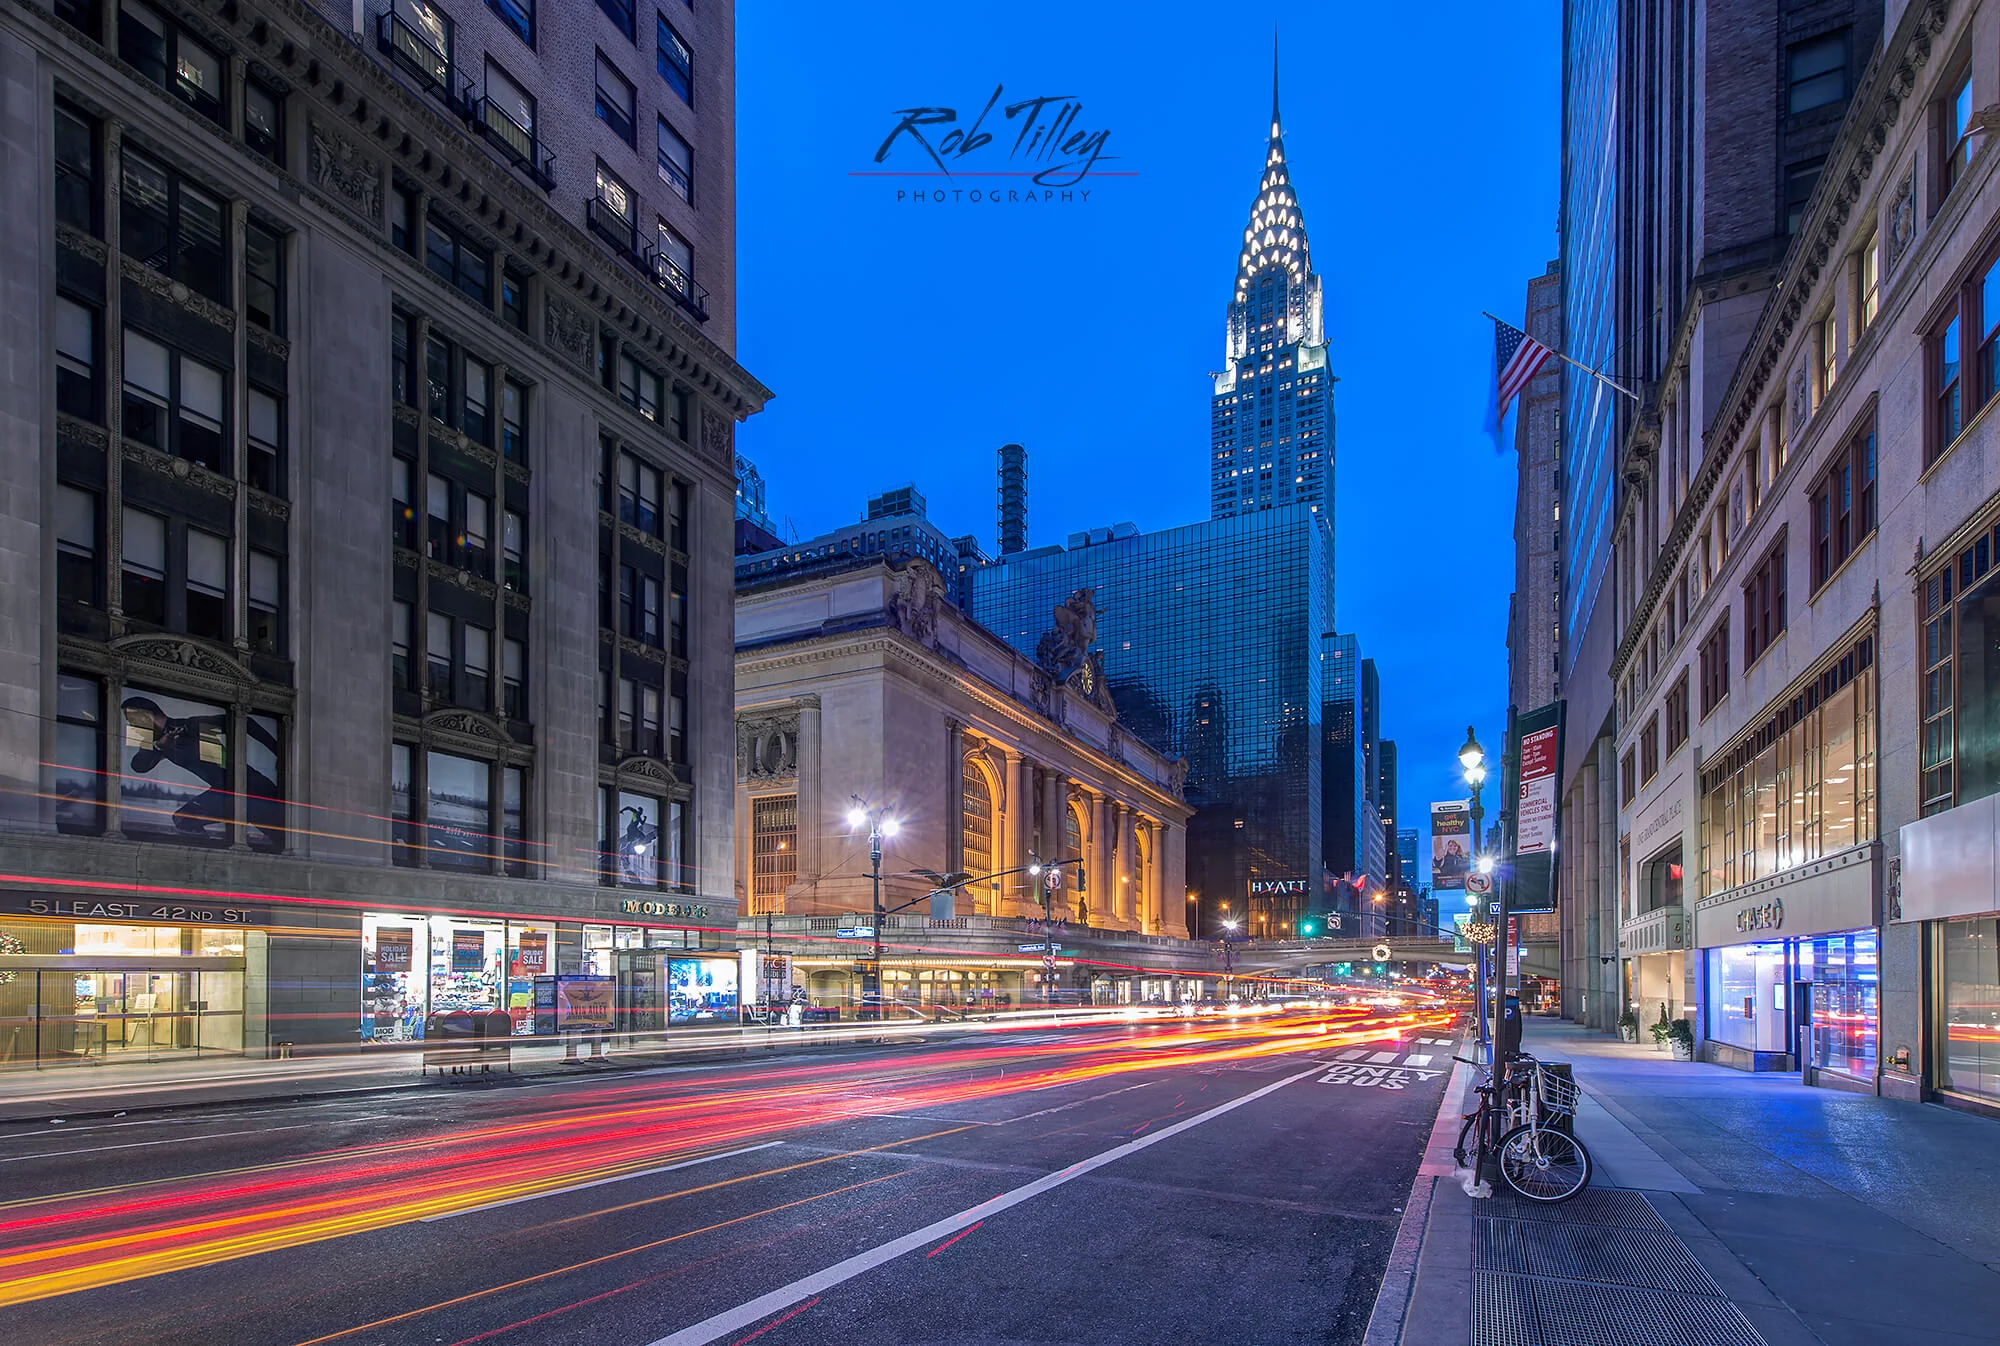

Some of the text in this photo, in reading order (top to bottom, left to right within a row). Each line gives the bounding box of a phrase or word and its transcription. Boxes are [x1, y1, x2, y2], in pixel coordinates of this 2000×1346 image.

[1521, 785, 1527, 798] 3
[1520, 797, 1548, 810] COMMERCIAL
[1520, 803, 1552, 816] VEHICLES ONLY
[1436, 819, 1464, 828] healthy
[1442, 825, 1459, 833] NYC
[1252, 880, 1306, 894] HYATT
[29, 899, 253, 923] 51 EAST 42ND ST.
[380, 945, 407, 953] HOLIDAY
[380, 953, 407, 963] SALE
[522, 955, 544, 965] SALE
[1328, 1065, 1445, 1081] ONLY
[1317, 1073, 1410, 1090] BUS
